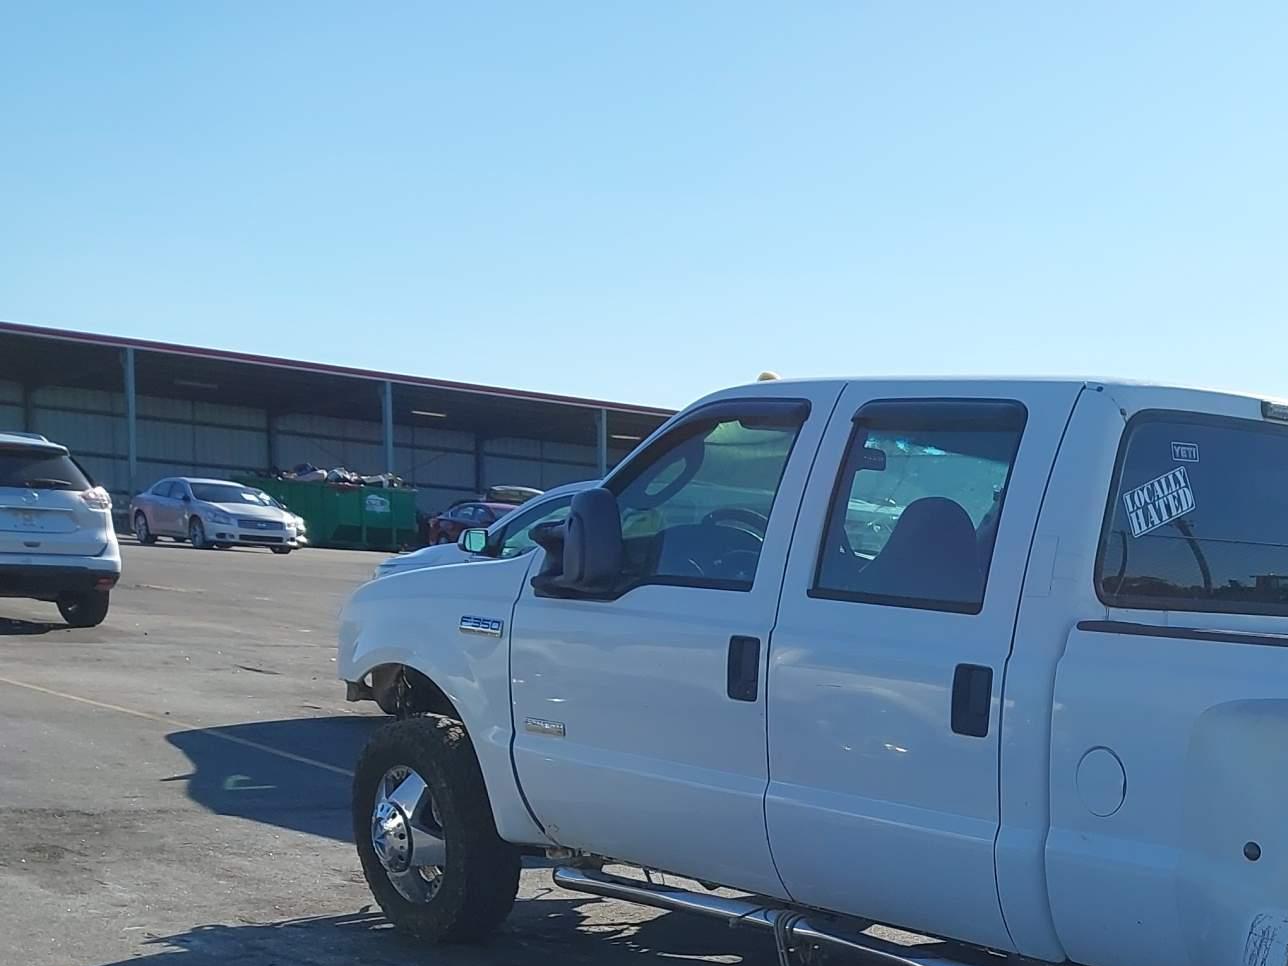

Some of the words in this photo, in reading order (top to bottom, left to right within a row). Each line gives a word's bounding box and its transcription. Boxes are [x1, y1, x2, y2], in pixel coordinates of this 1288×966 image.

[1174, 445, 1196, 460] YETI
[1125, 468, 1186, 513] LOCALLY
[1130, 487, 1193, 535] HATED
